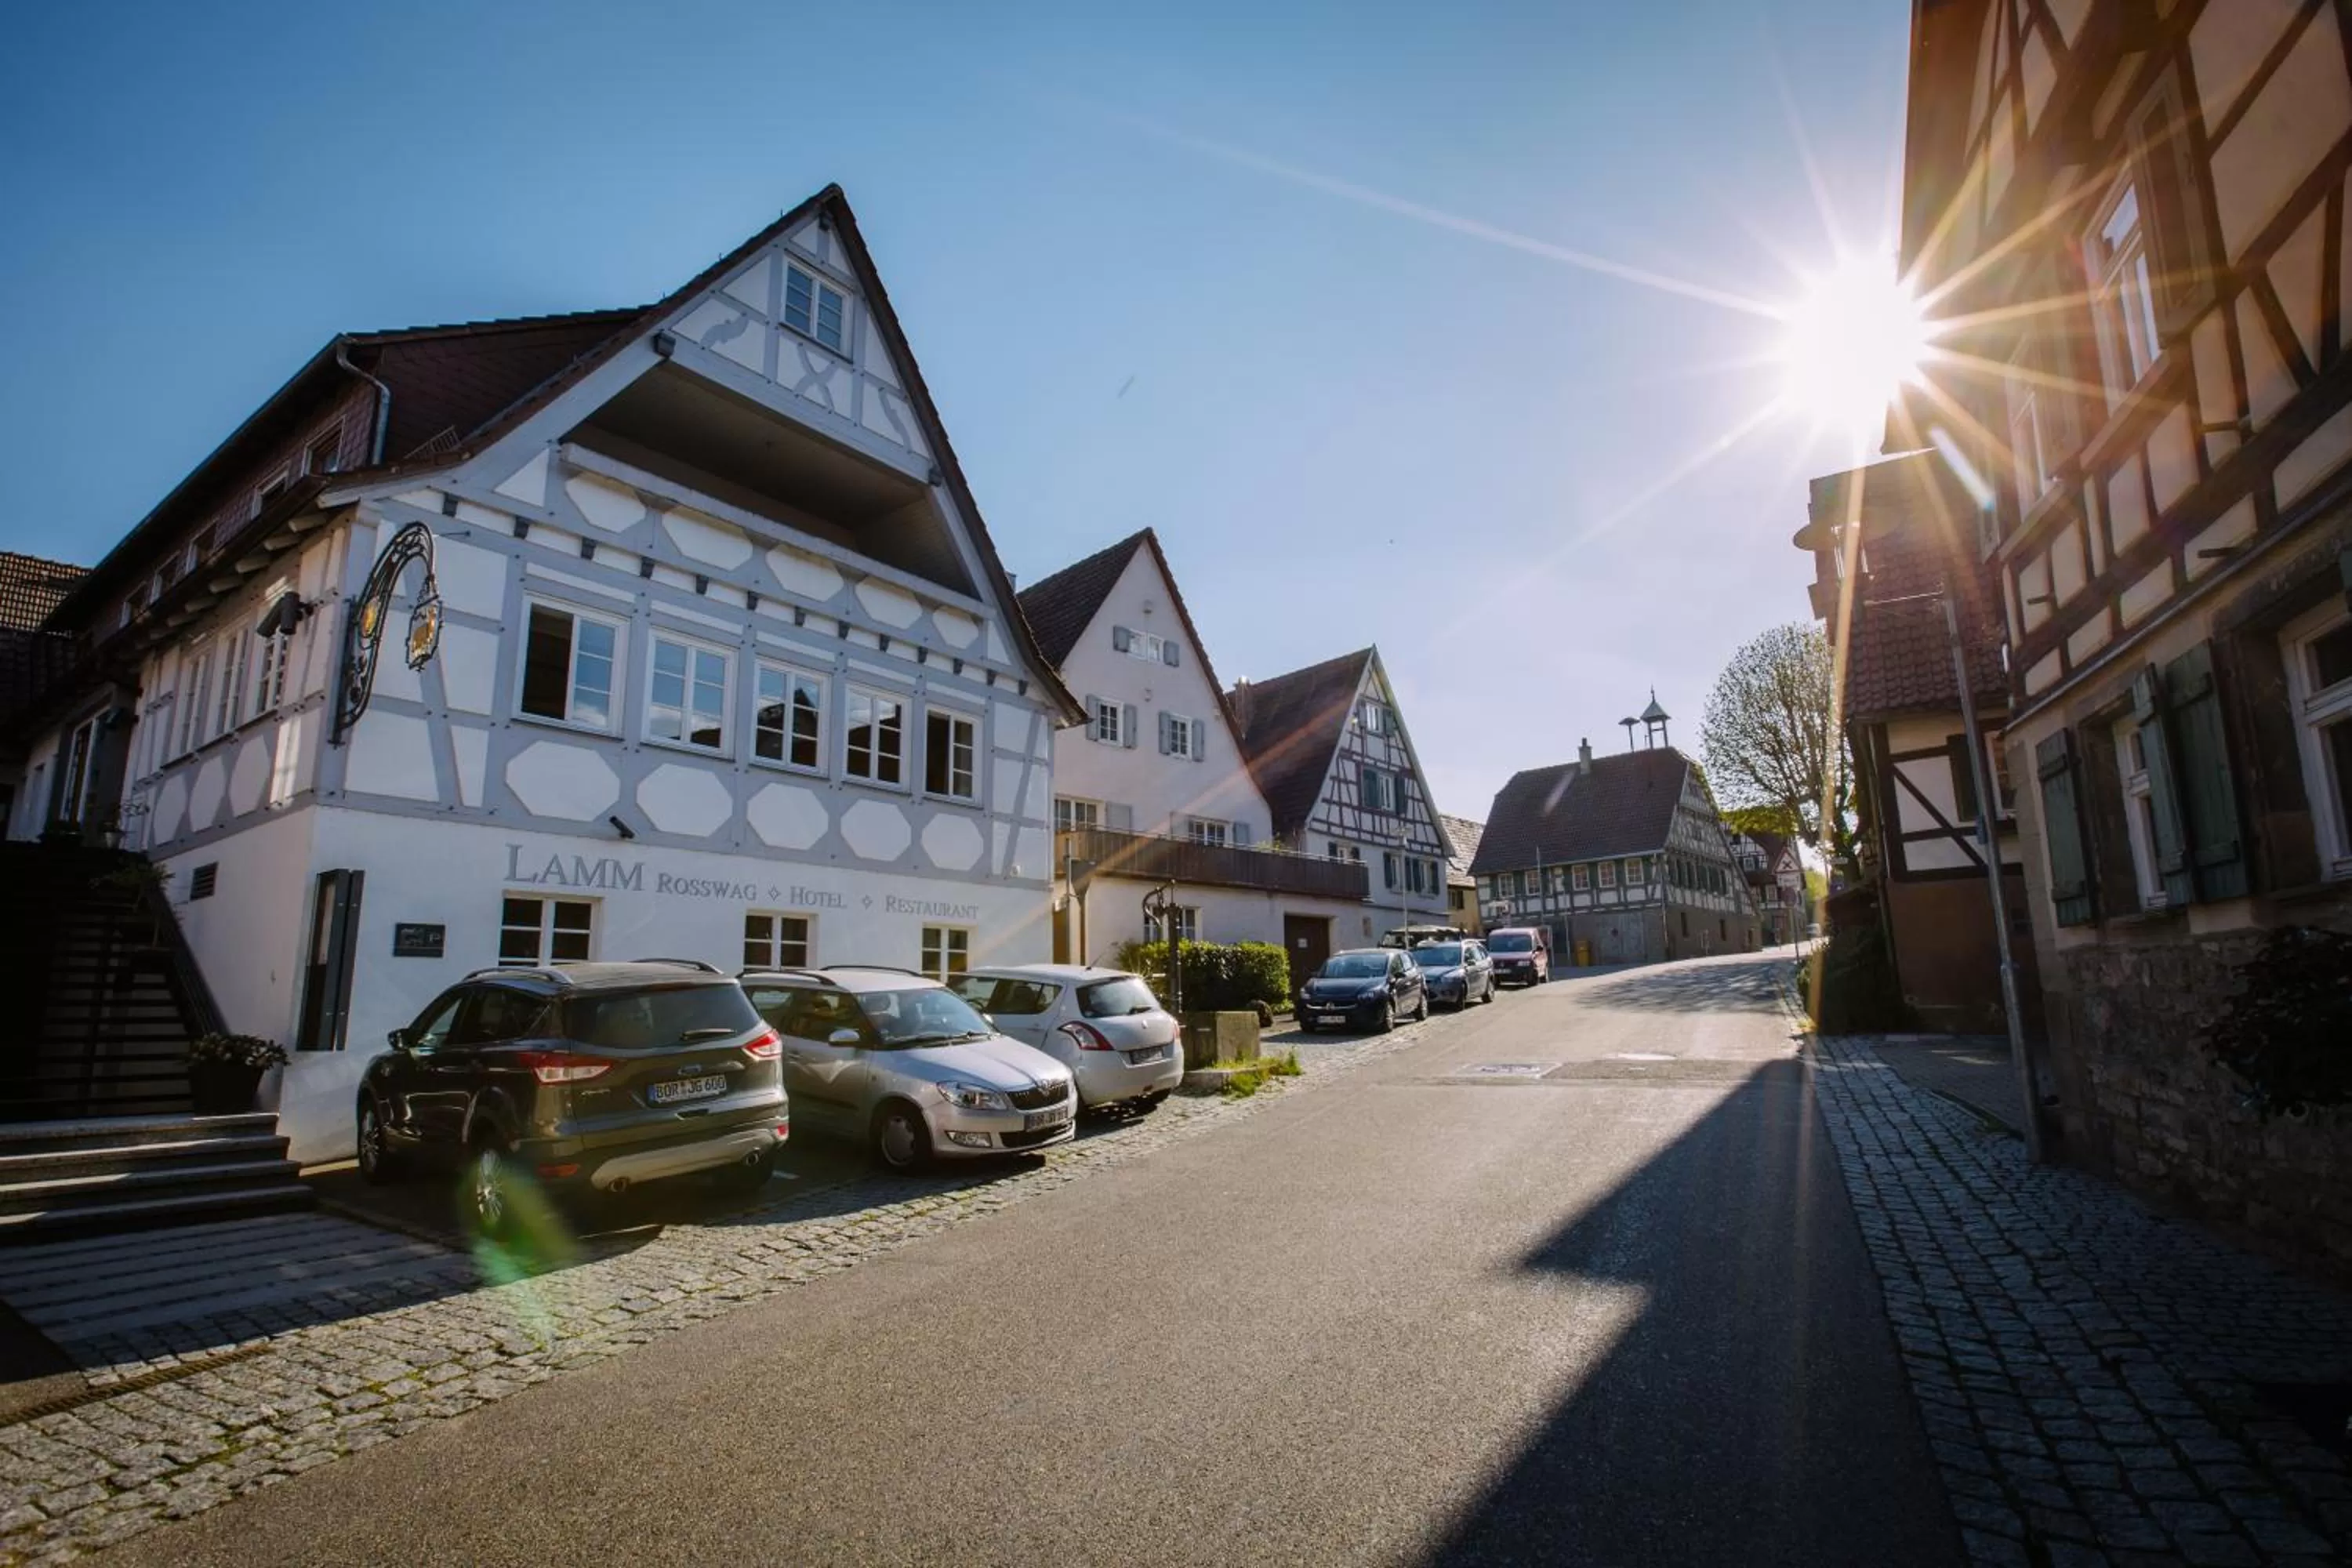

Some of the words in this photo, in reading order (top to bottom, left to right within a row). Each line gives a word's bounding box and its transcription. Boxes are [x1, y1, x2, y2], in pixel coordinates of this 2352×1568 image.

[503, 843, 645, 891] LAMM
[655, 872, 757, 901] ROSSWAG
[789, 885, 848, 909] HOTEL
[885, 895, 979, 920] RESTAURANT
